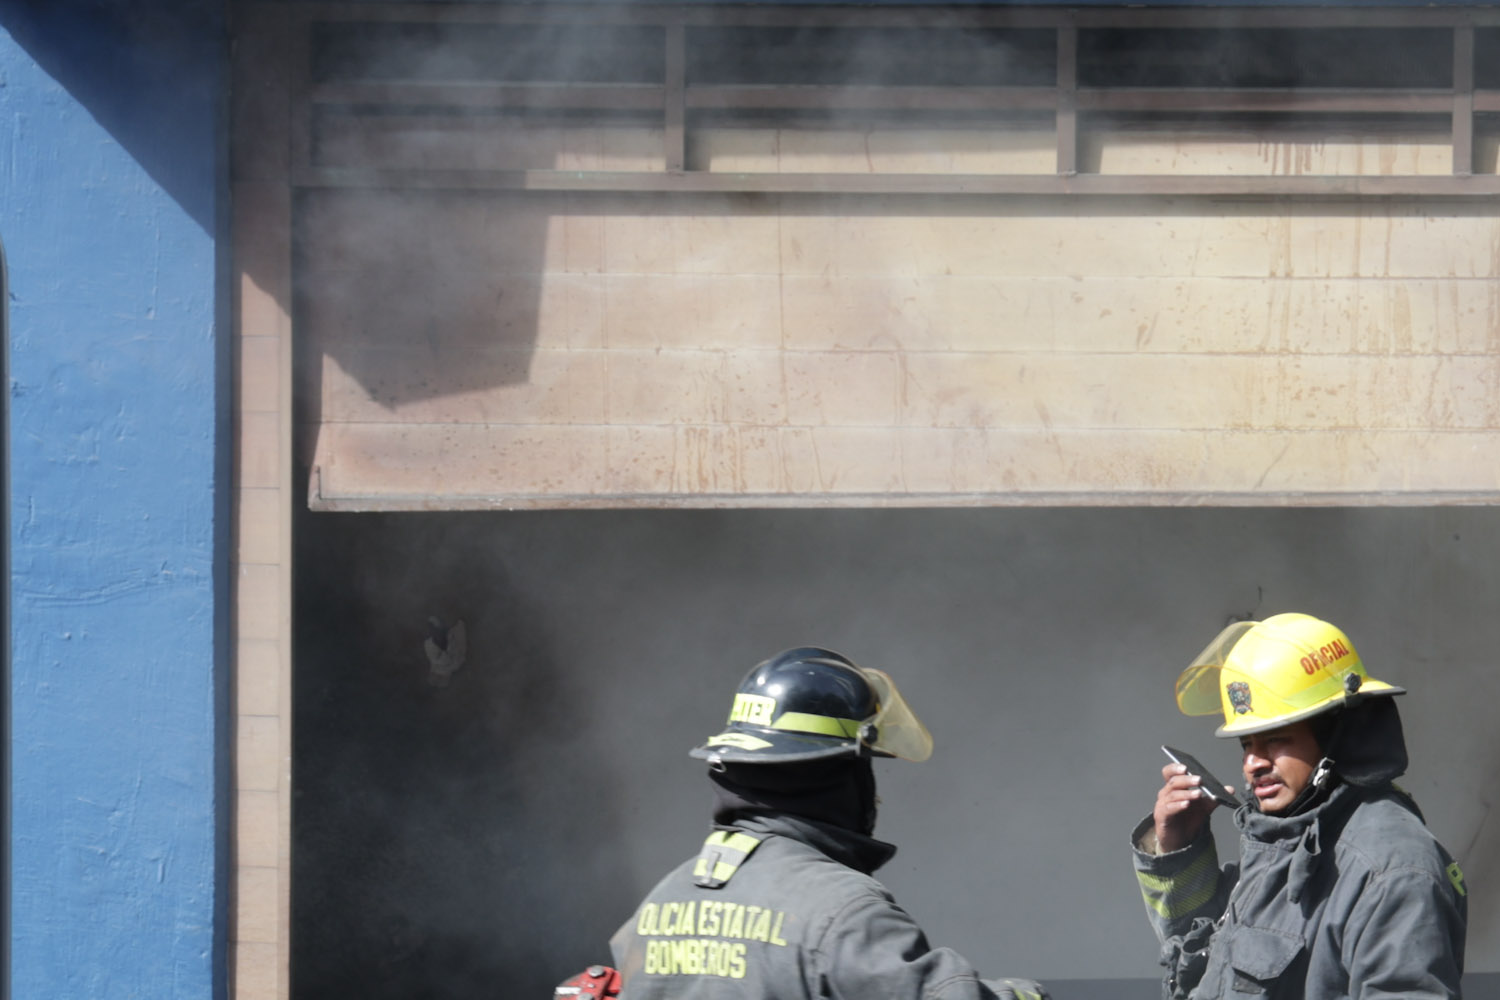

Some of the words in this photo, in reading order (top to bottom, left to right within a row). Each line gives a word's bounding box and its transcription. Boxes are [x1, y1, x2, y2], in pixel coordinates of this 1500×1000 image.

[1300, 639, 1349, 675] OFICIAL
[637, 900, 696, 936] OLICIA
[697, 900, 788, 946] ESTATAL
[645, 939, 747, 979] BOMBEROS
